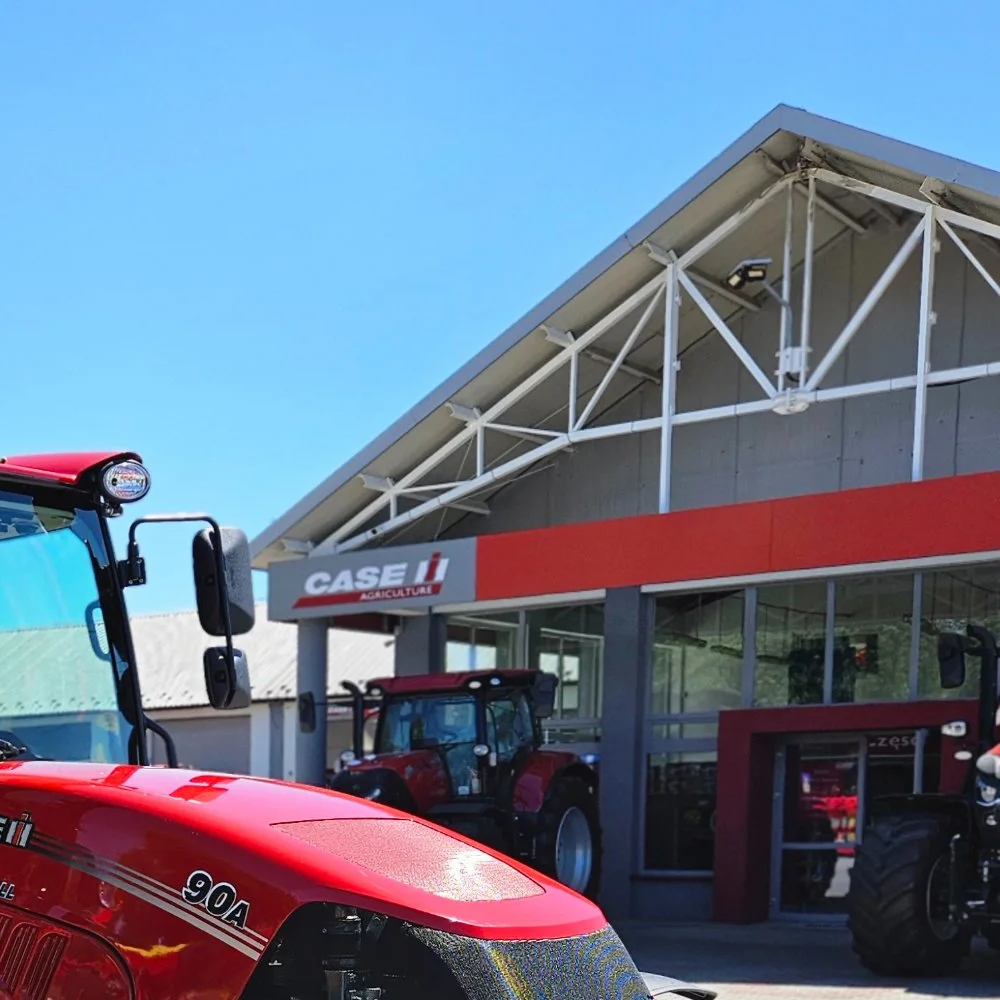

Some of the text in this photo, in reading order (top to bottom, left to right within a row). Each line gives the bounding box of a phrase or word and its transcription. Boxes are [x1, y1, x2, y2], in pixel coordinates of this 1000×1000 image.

[304, 562, 408, 595] CASE
[360, 585, 433, 601] AGRICULTURE
[182, 870, 250, 929] 90A
